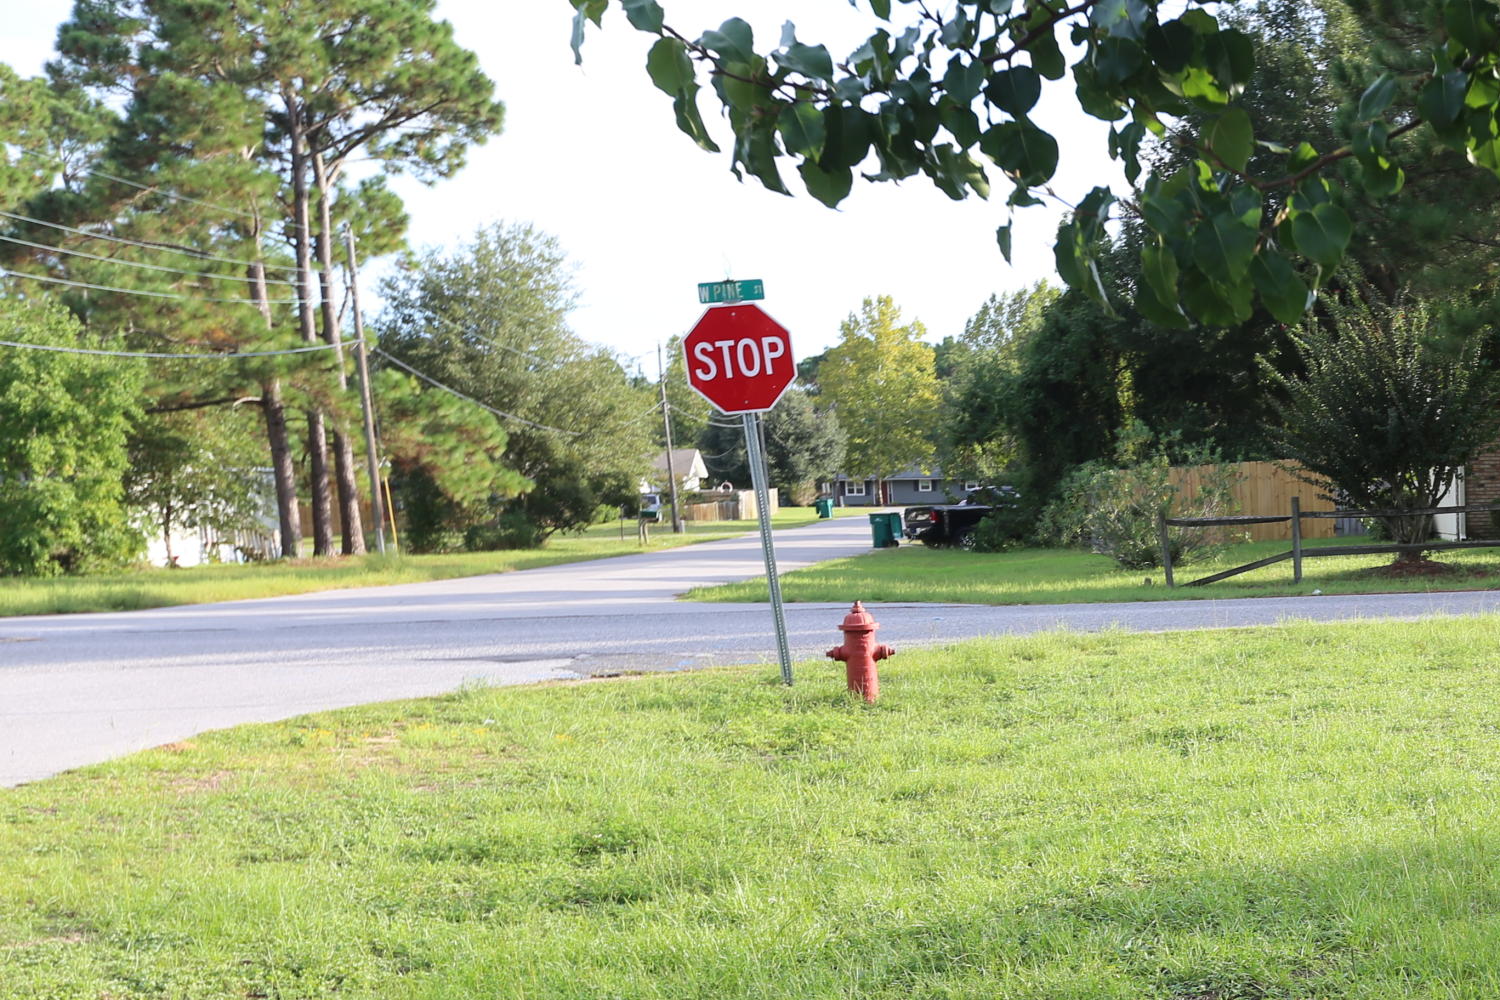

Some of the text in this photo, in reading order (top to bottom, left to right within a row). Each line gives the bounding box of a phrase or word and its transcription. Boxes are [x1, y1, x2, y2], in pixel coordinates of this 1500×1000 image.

[699, 282, 763, 302] W PINE ST
[694, 336, 785, 381] STOP
